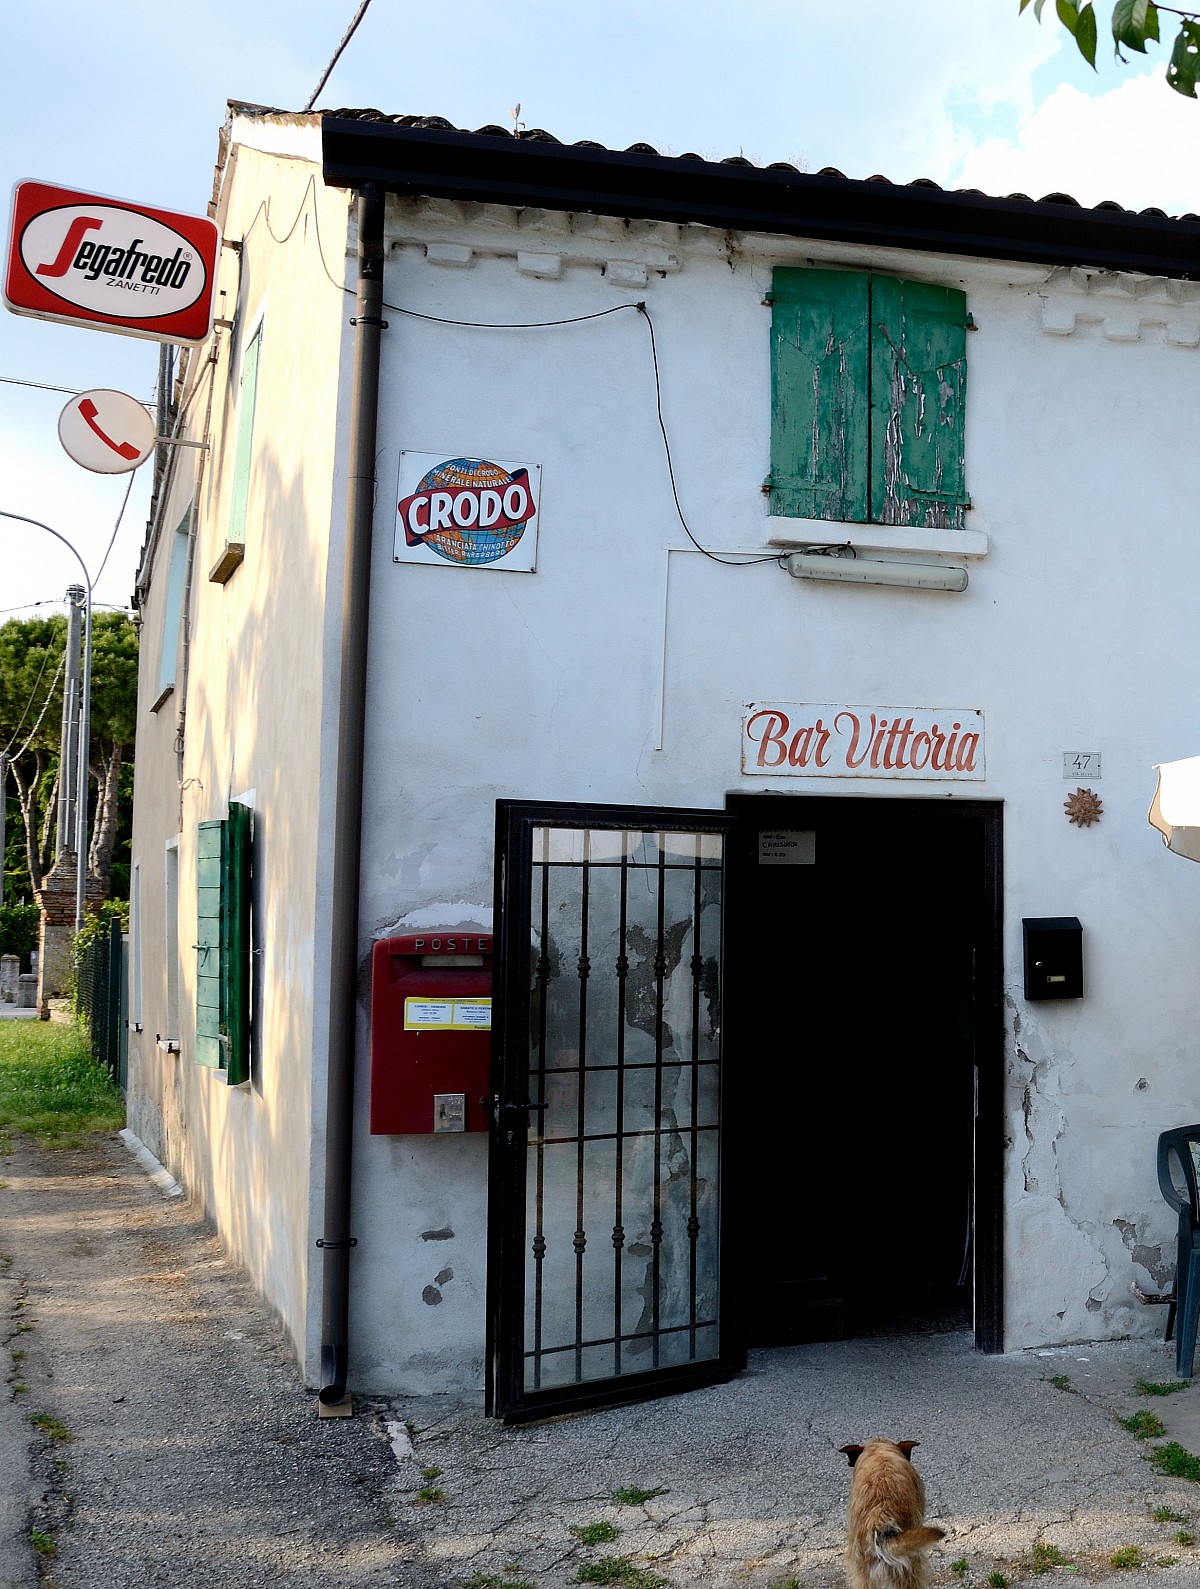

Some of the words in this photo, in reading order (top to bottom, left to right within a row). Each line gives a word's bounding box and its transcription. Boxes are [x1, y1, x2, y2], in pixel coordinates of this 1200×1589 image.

[35, 216, 192, 290] Segafredo
[106, 277, 160, 296] ZANETTI
[433, 469, 471, 487] MINERALE
[472, 476, 512, 488] NATURALE
[477, 469, 499, 477] CRODO
[408, 484, 528, 535] CRODO
[435, 534, 477, 550] ARANCIATA
[478, 539, 515, 552] CHINOTTO
[746, 709, 832, 768] Bar
[834, 711, 980, 772] Vittoria
[1072, 754, 1091, 769] 47
[415, 938, 488, 951] POSTE
